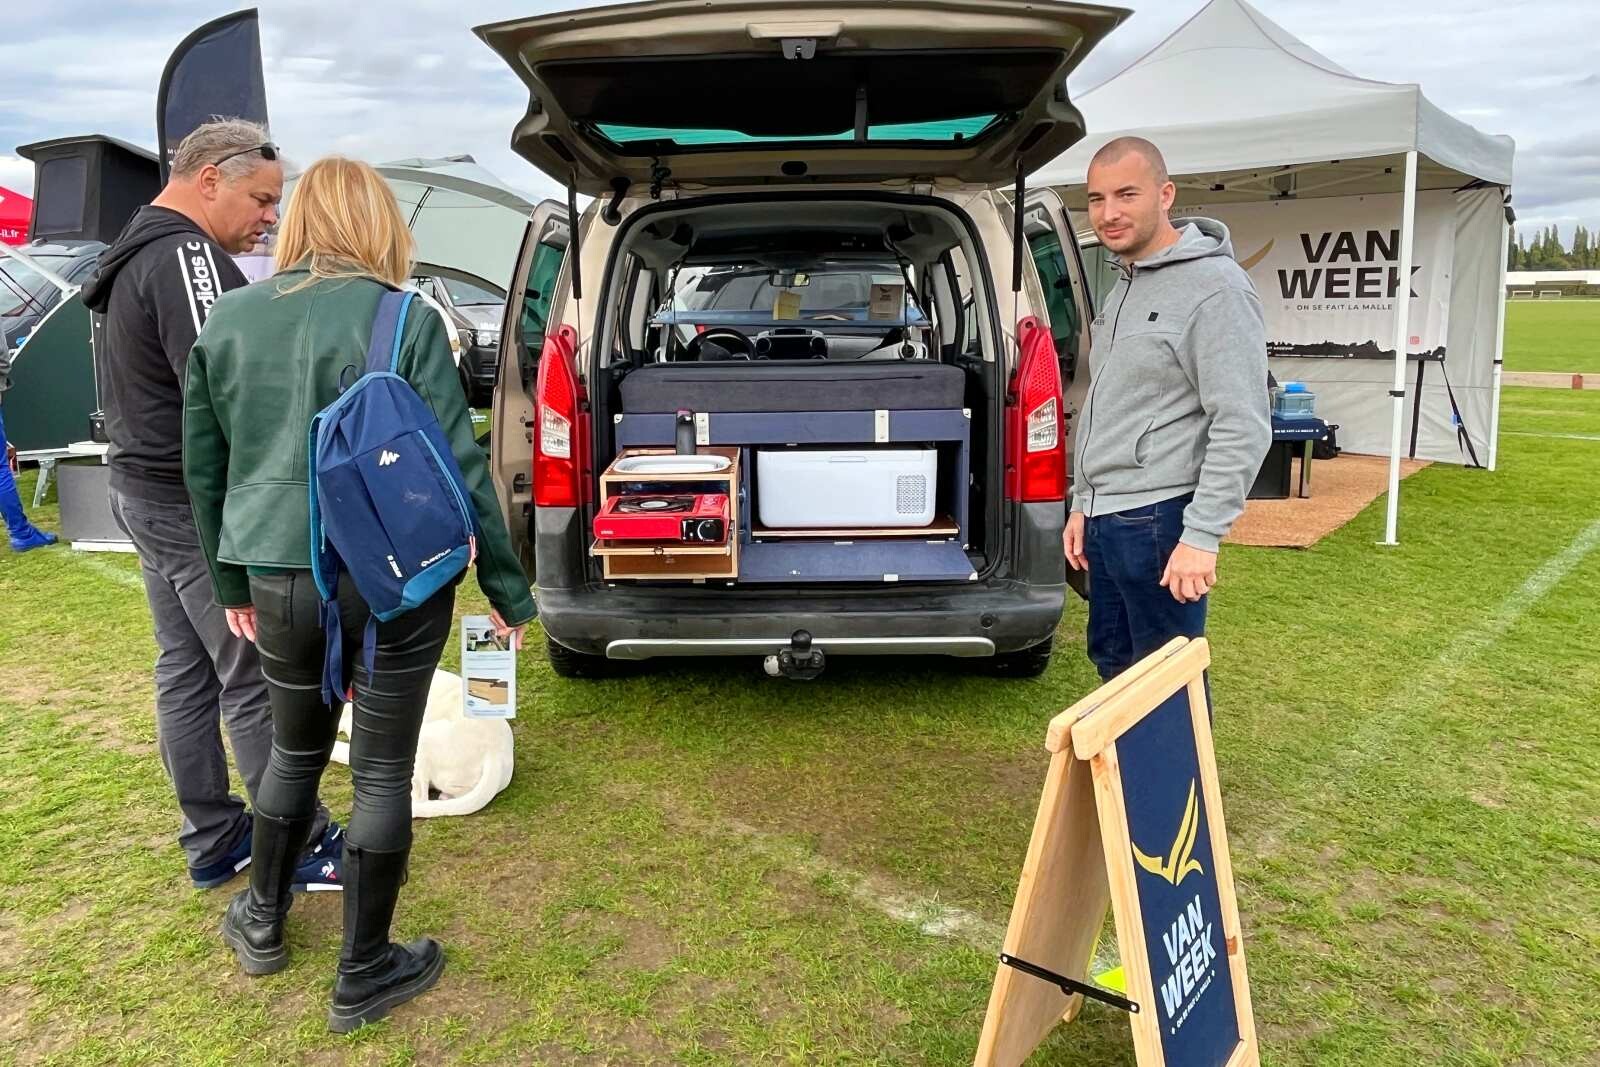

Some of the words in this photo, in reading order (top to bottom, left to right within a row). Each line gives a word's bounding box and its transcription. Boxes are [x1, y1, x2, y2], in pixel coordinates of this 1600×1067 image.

[1300, 229, 1400, 264] VAN
[192, 255, 215, 318] didas
[1347, 303, 1360, 311] LA
[1362, 303, 1393, 311] MALLE
[1162, 893, 1204, 966] VAN
[1160, 921, 1217, 1019] WEEK
